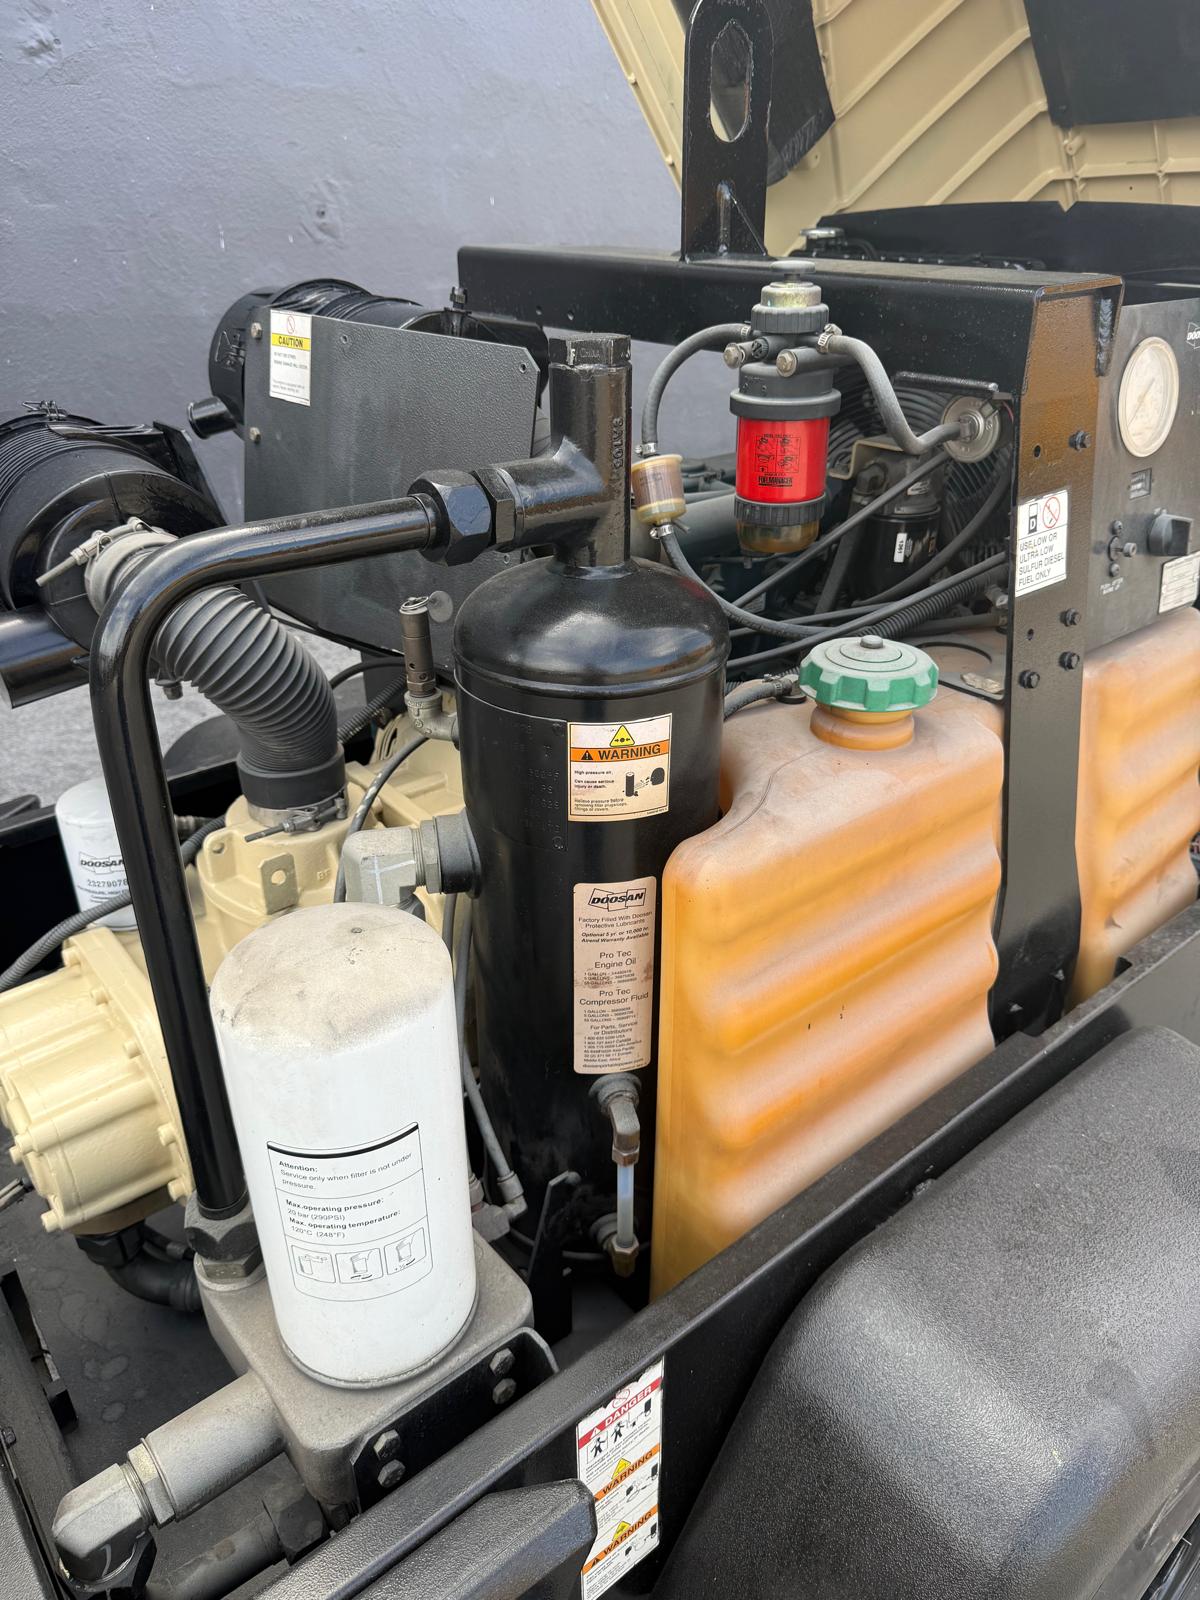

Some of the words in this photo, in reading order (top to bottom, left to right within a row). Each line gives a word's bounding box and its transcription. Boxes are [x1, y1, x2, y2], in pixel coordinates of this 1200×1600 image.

[278, 336, 303, 348] CAUTION
[1019, 539, 1033, 551] USE
[1033, 535, 1047, 547] LOW
[1048, 532, 1058, 542] OR
[1019, 551, 1038, 563] ULTRA
[1040, 544, 1054, 556] LOW
[1018, 560, 1043, 575] SULFUR
[1044, 552, 1064, 565] DIESEL
[1018, 575, 1034, 587] FUEL
[1035, 568, 1051, 580] ONLY
[598, 744, 661, 760] WARNING
[591, 892, 644, 904] DOOSAN
[632, 911, 652, 919] Doosan
[616, 918, 645, 928] Lubricants
[626, 927, 642, 935] 10,000
[626, 931, 649, 940] Available
[594, 961, 623, 969] Engine
[625, 957, 637, 965] Oil
[579, 998, 629, 1006] Compressor
[630, 992, 649, 1002] Fluid
[278, 1160, 318, 1172] Attention:
[280, 1169, 307, 1181] Service
[308, 1174, 325, 1182] only
[326, 1174, 349, 1182] when
[350, 1170, 368, 1179] filter
[377, 1163, 390, 1173] not
[391, 1153, 412, 1167] under
[282, 1179, 316, 1190] pressure.
[344, 1197, 384, 1211] pressure:
[289, 1217, 306, 1227] Max.
[308, 1221, 346, 1230] operating
[348, 1210, 401, 1228] temperature:
[604, 1386, 652, 1427] DANGER
[602, 1451, 653, 1495] WARNING
[603, 1511, 652, 1556] WARNING
